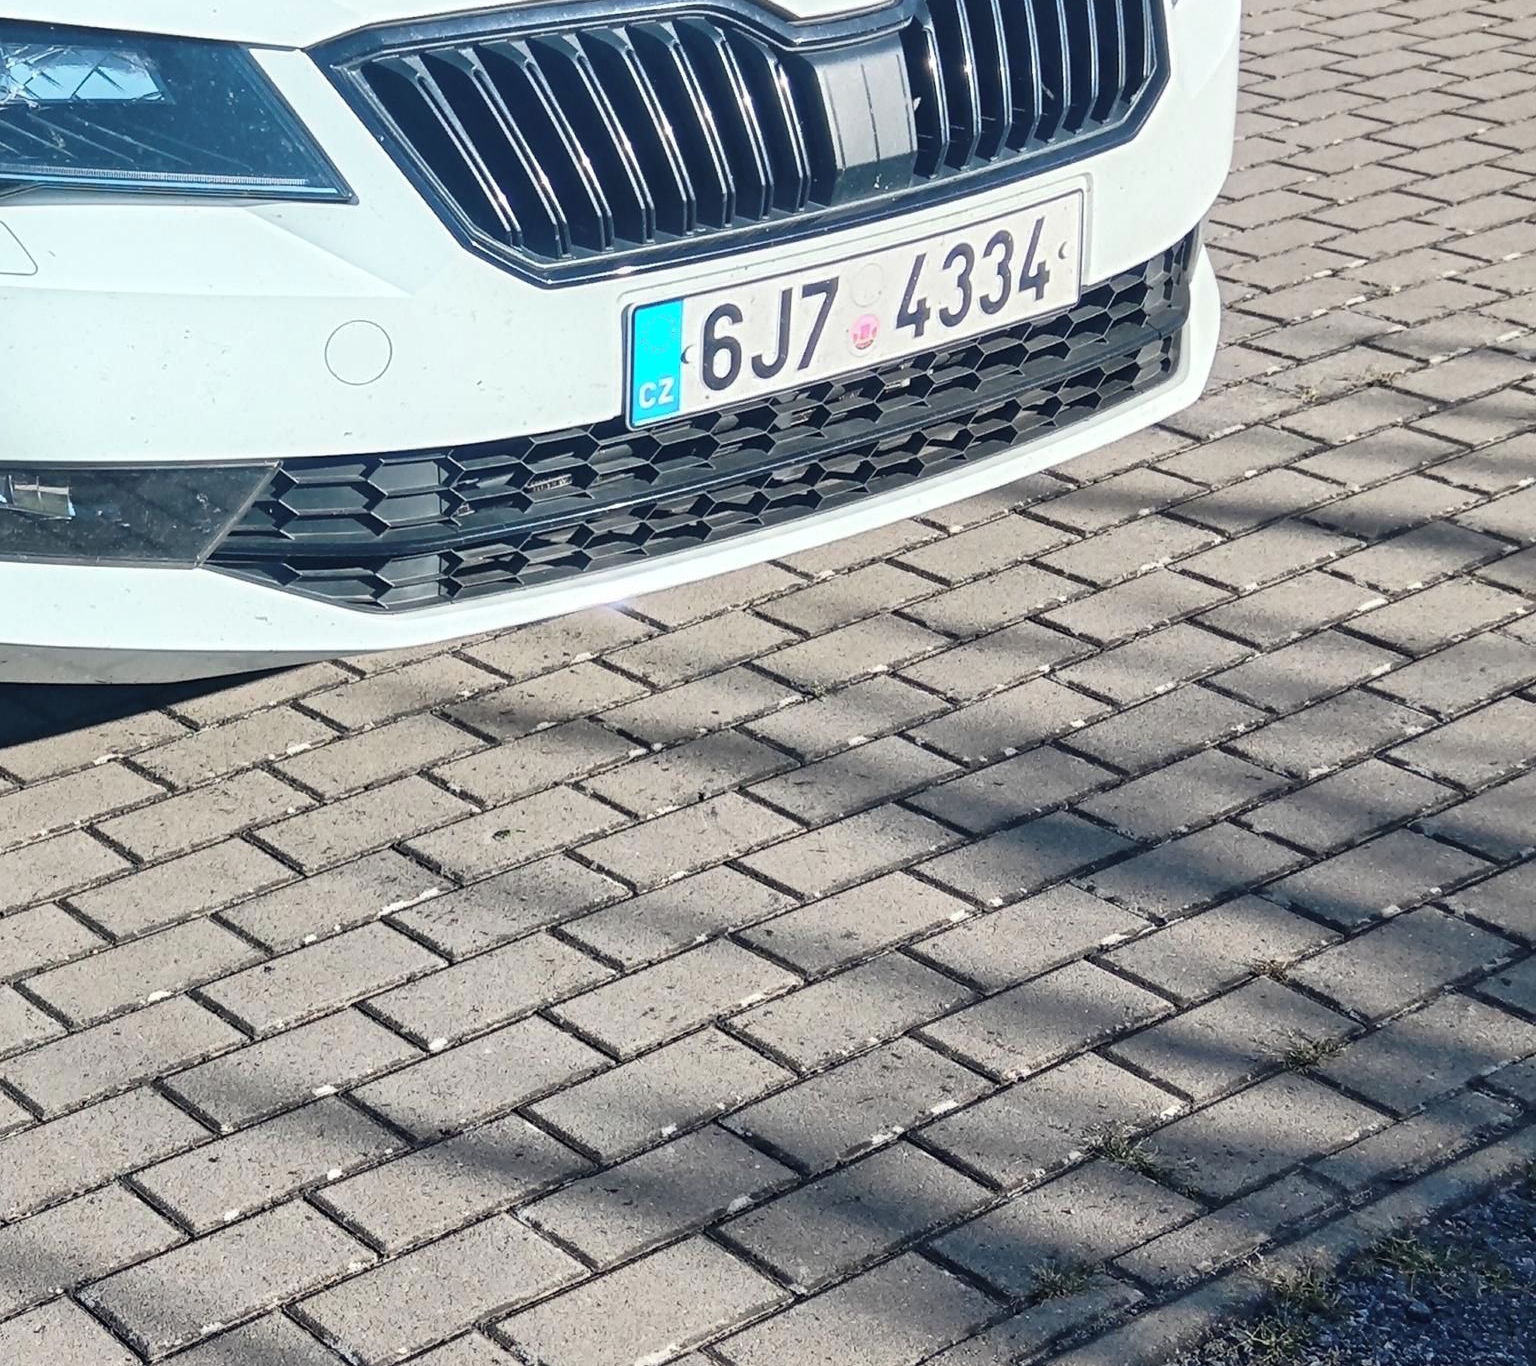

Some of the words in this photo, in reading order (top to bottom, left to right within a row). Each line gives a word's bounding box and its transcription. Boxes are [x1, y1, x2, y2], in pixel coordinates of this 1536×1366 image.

[702, 276, 840, 392] 6J7
[895, 218, 1051, 338] 4334
[639, 379, 675, 409] CZ
